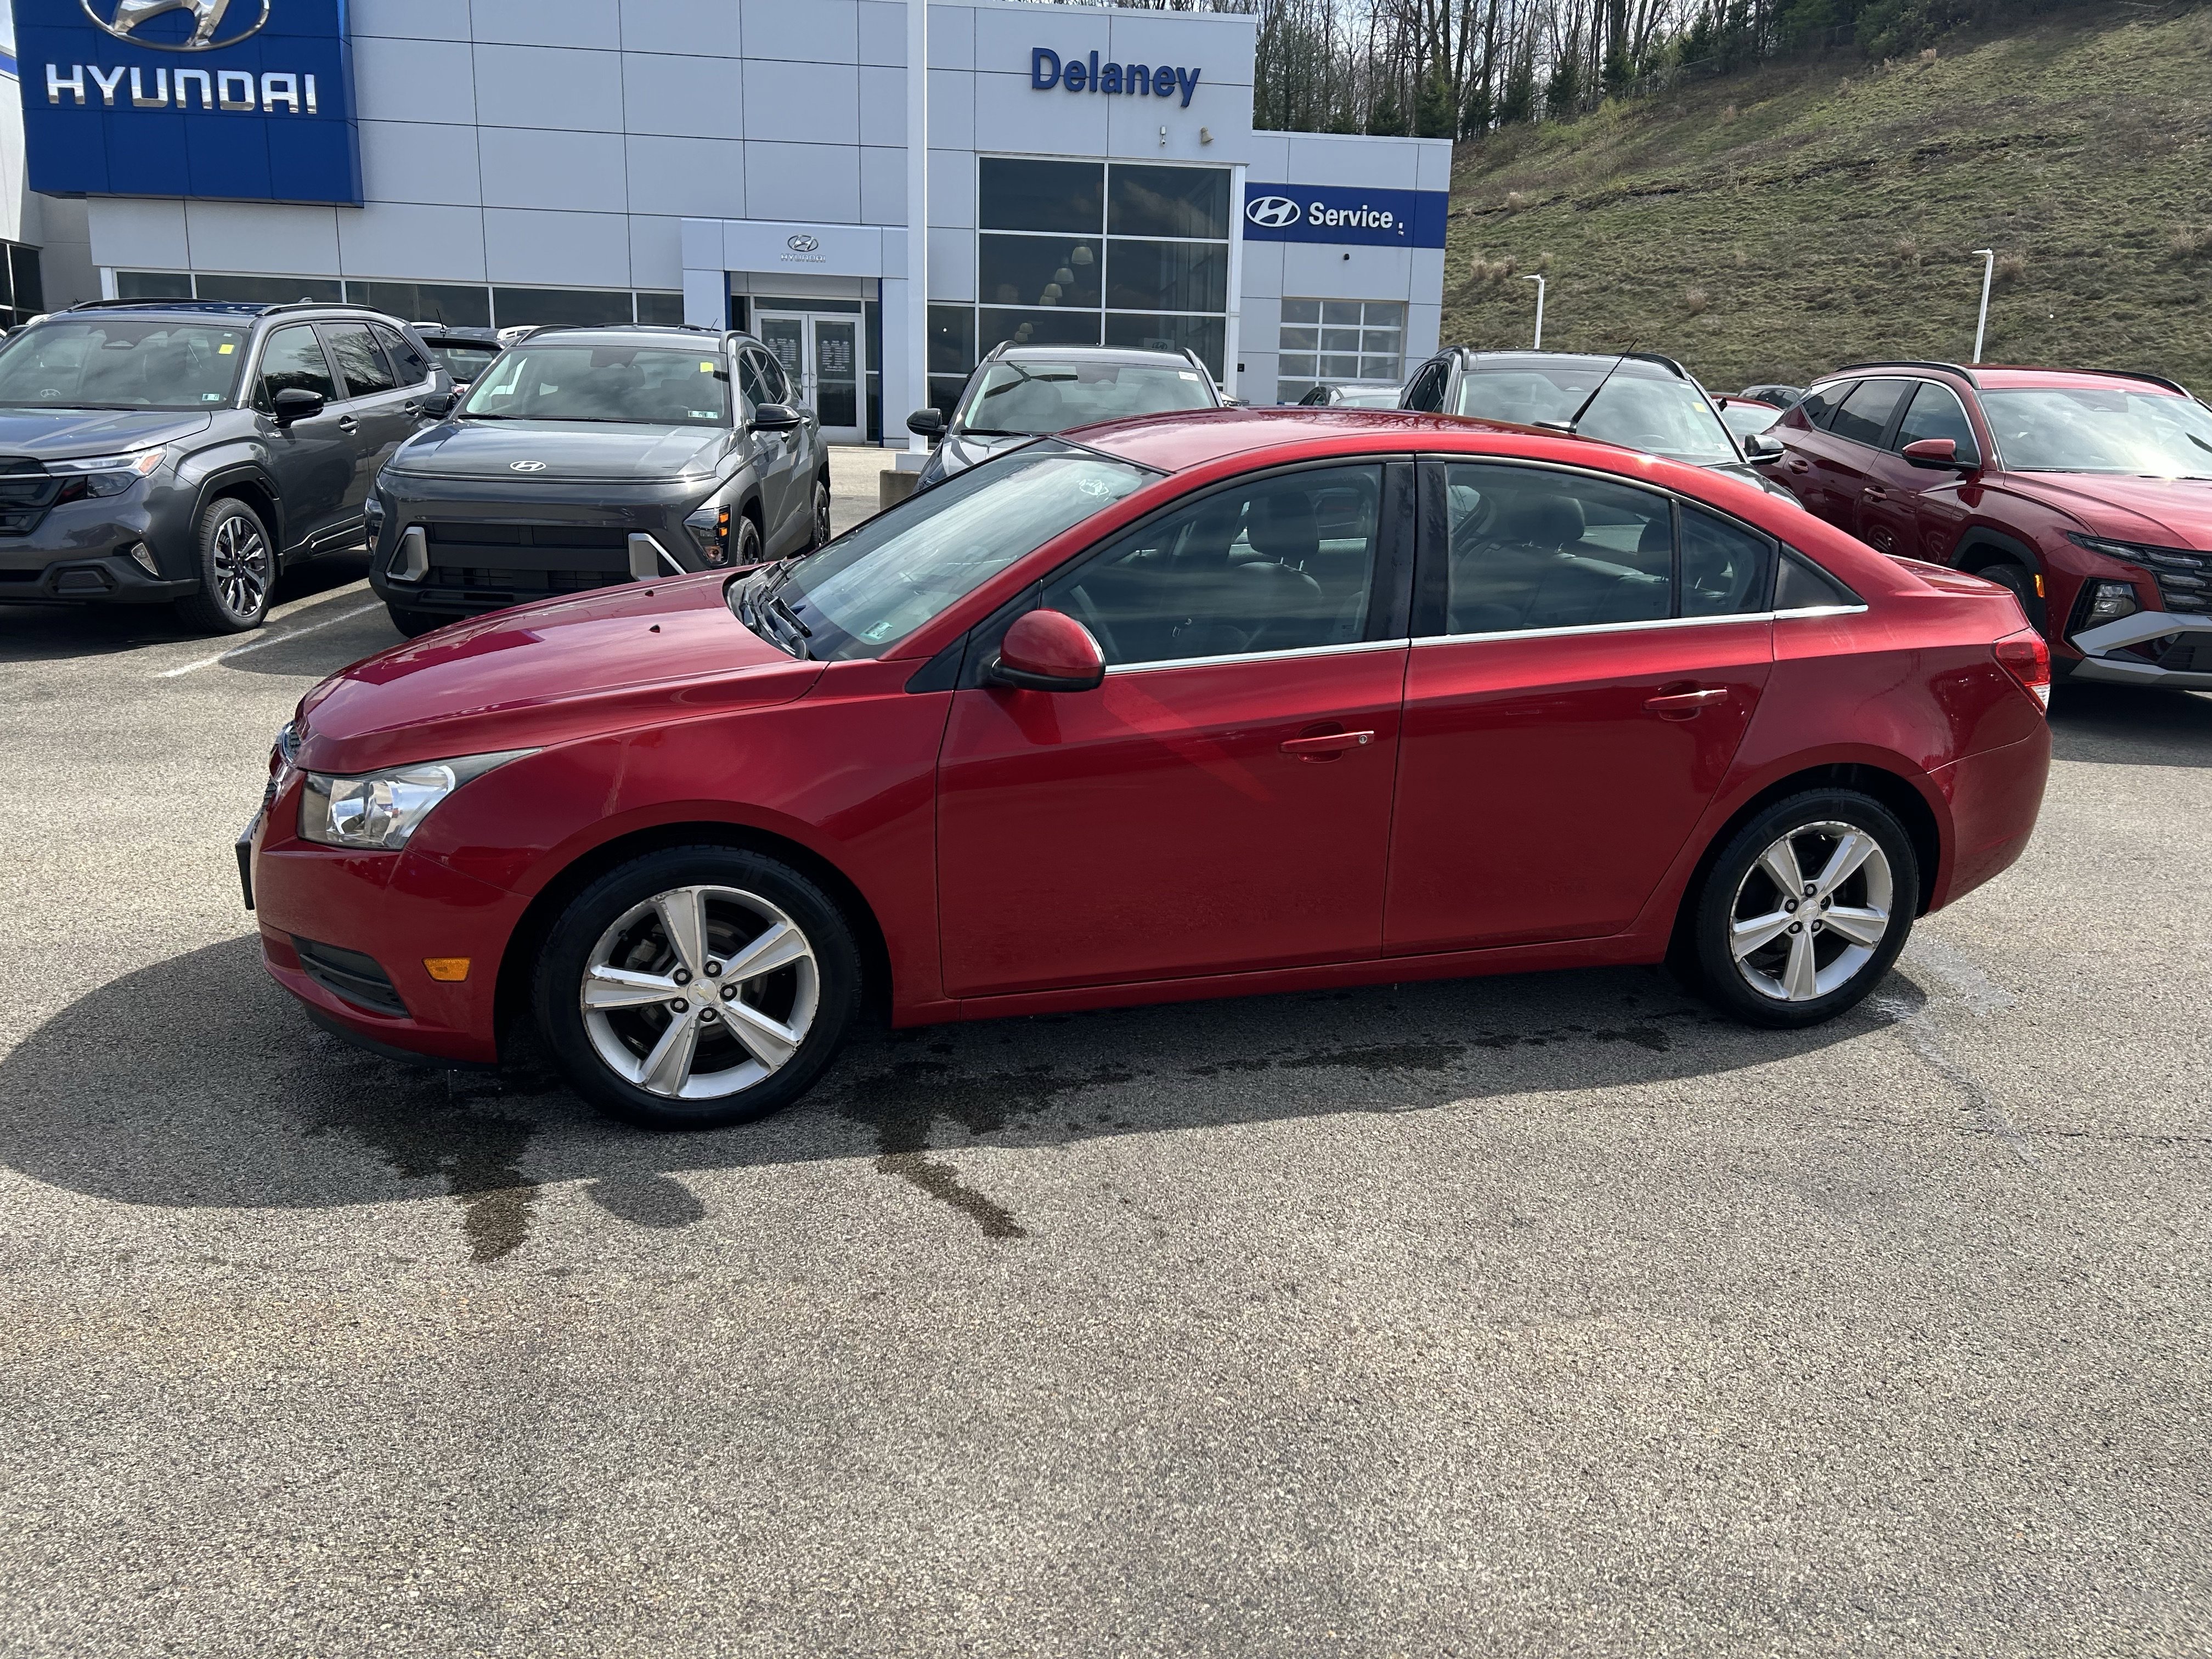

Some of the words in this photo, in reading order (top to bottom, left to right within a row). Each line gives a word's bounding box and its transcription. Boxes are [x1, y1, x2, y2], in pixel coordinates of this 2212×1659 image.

[45, 64, 317, 114] HYUNDAI
[1032, 47, 1201, 108] Delaney
[1308, 202, 1393, 228] Service
[781, 253, 826, 263] HYUNDAI
